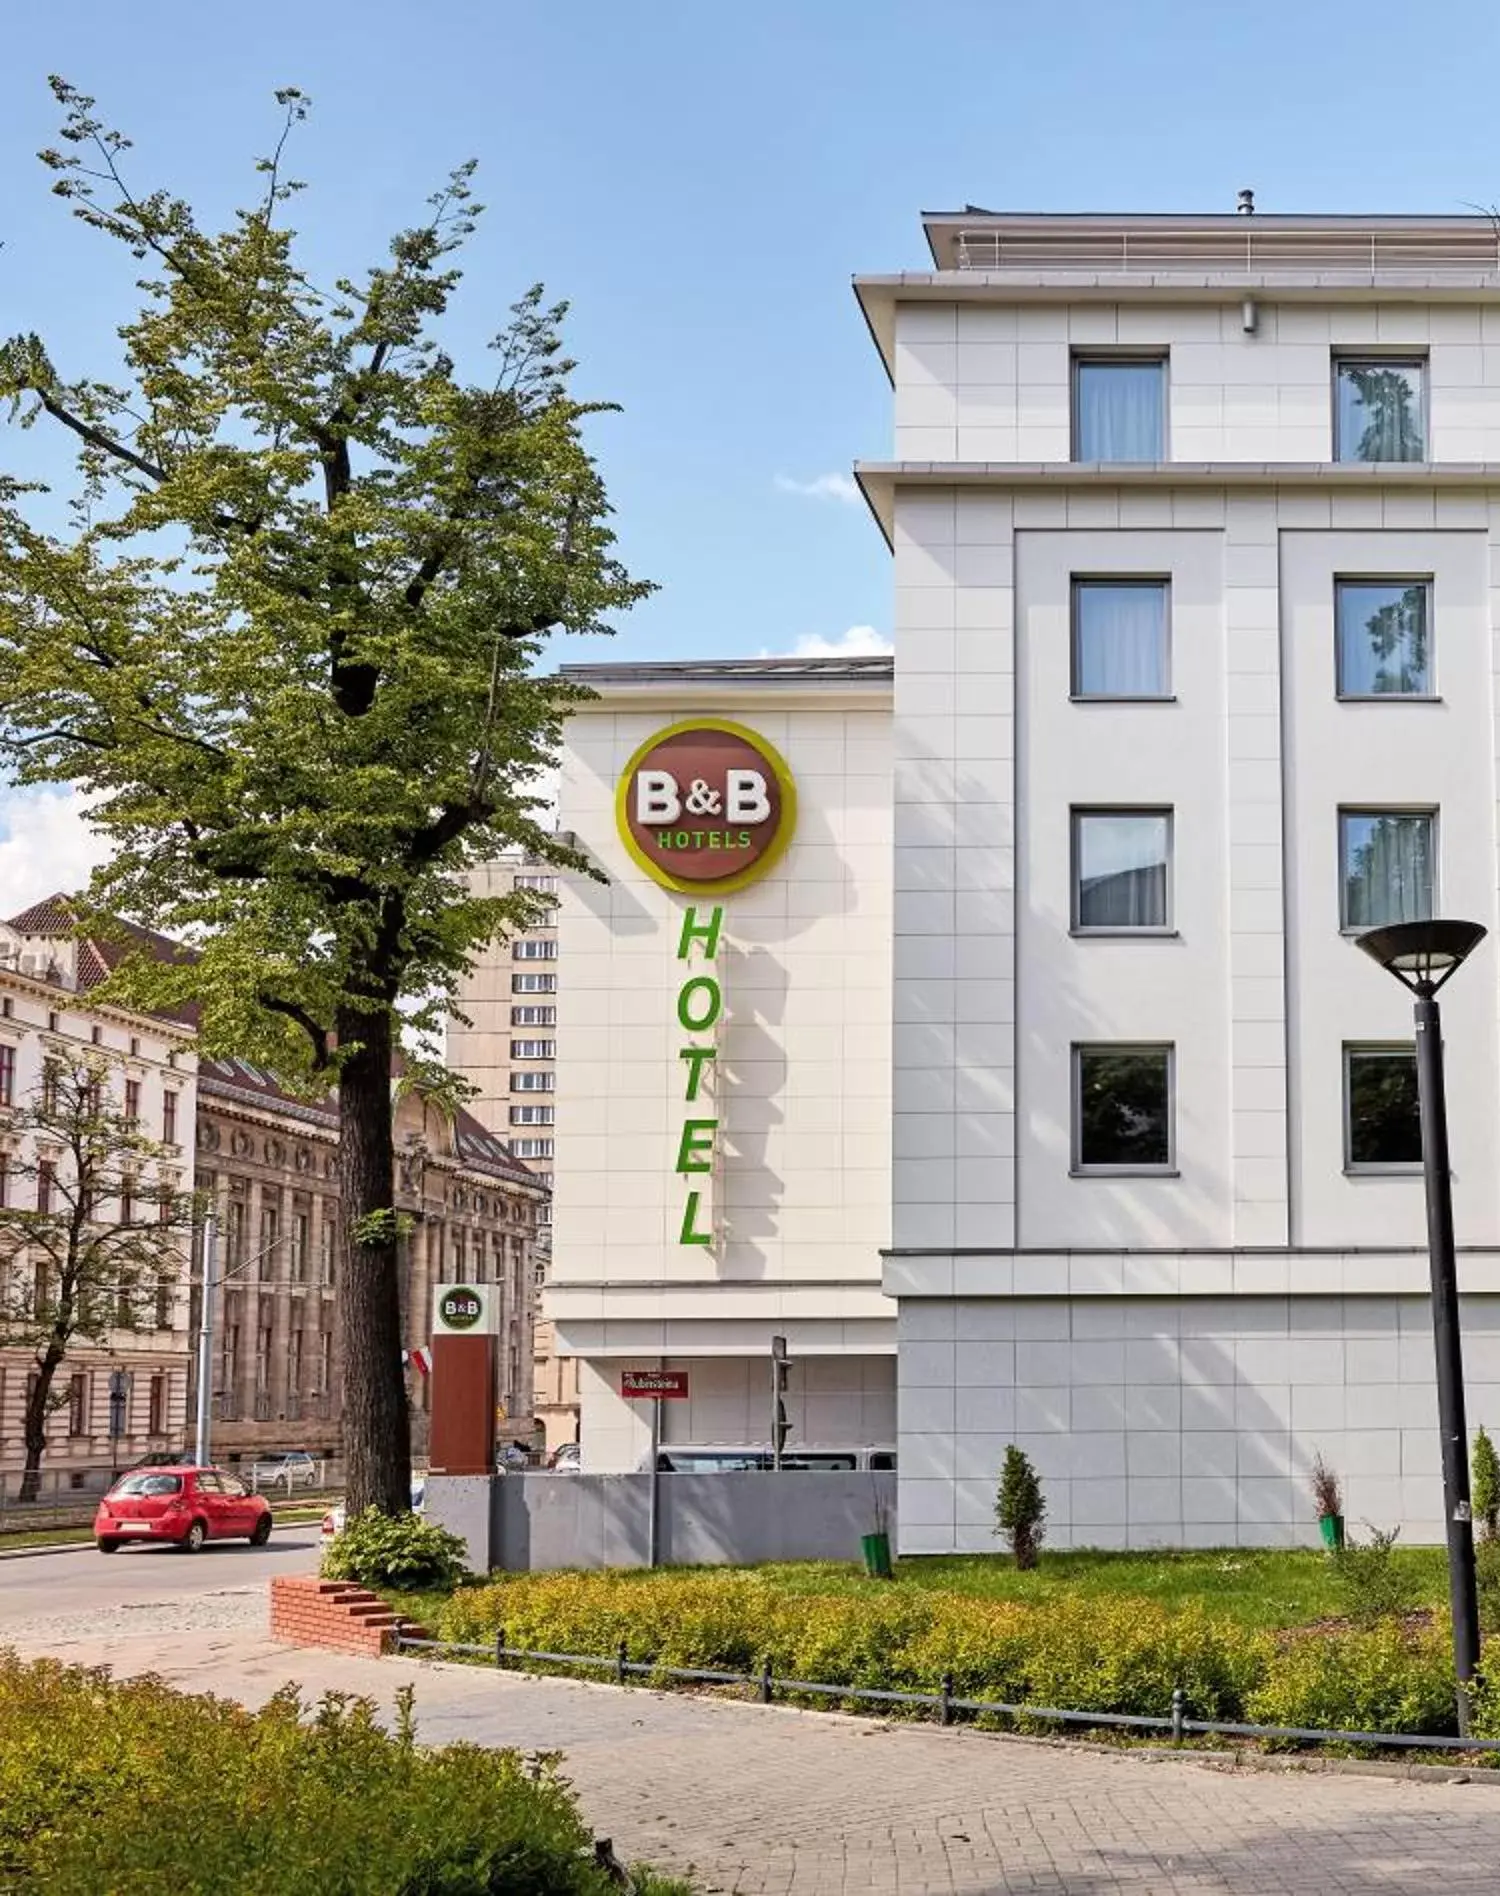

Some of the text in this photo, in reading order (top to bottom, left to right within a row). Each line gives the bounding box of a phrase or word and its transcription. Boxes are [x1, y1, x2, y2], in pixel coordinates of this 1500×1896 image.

[637, 769, 771, 825] B&B
[657, 831, 751, 849] HOTELS
[676, 906, 724, 1245] HOTEL
[445, 1301, 478, 1315] B&B
